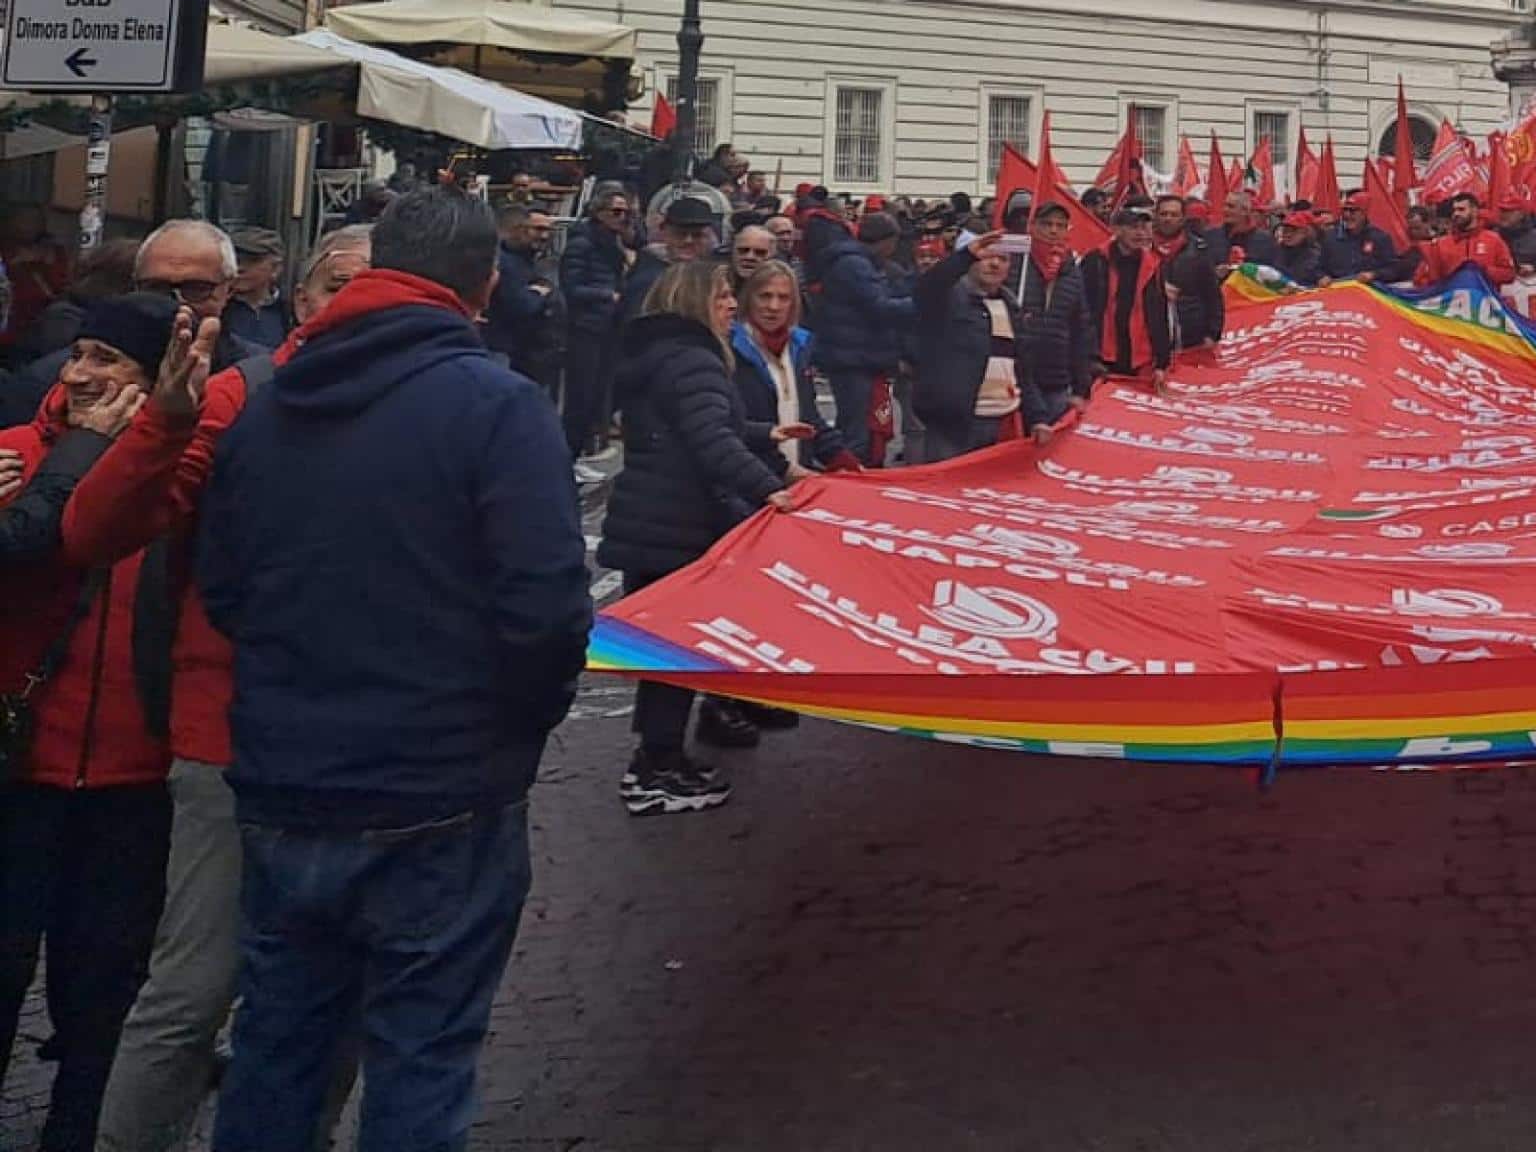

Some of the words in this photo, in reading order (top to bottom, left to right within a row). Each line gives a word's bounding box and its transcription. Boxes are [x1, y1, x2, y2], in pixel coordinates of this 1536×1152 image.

[17, 16, 67, 40] Dimora
[73, 17, 119, 41] Donna
[124, 18, 164, 42] Elena
[842, 531, 1130, 591] NAPOLI
[772, 560, 1011, 657] FILLEA
